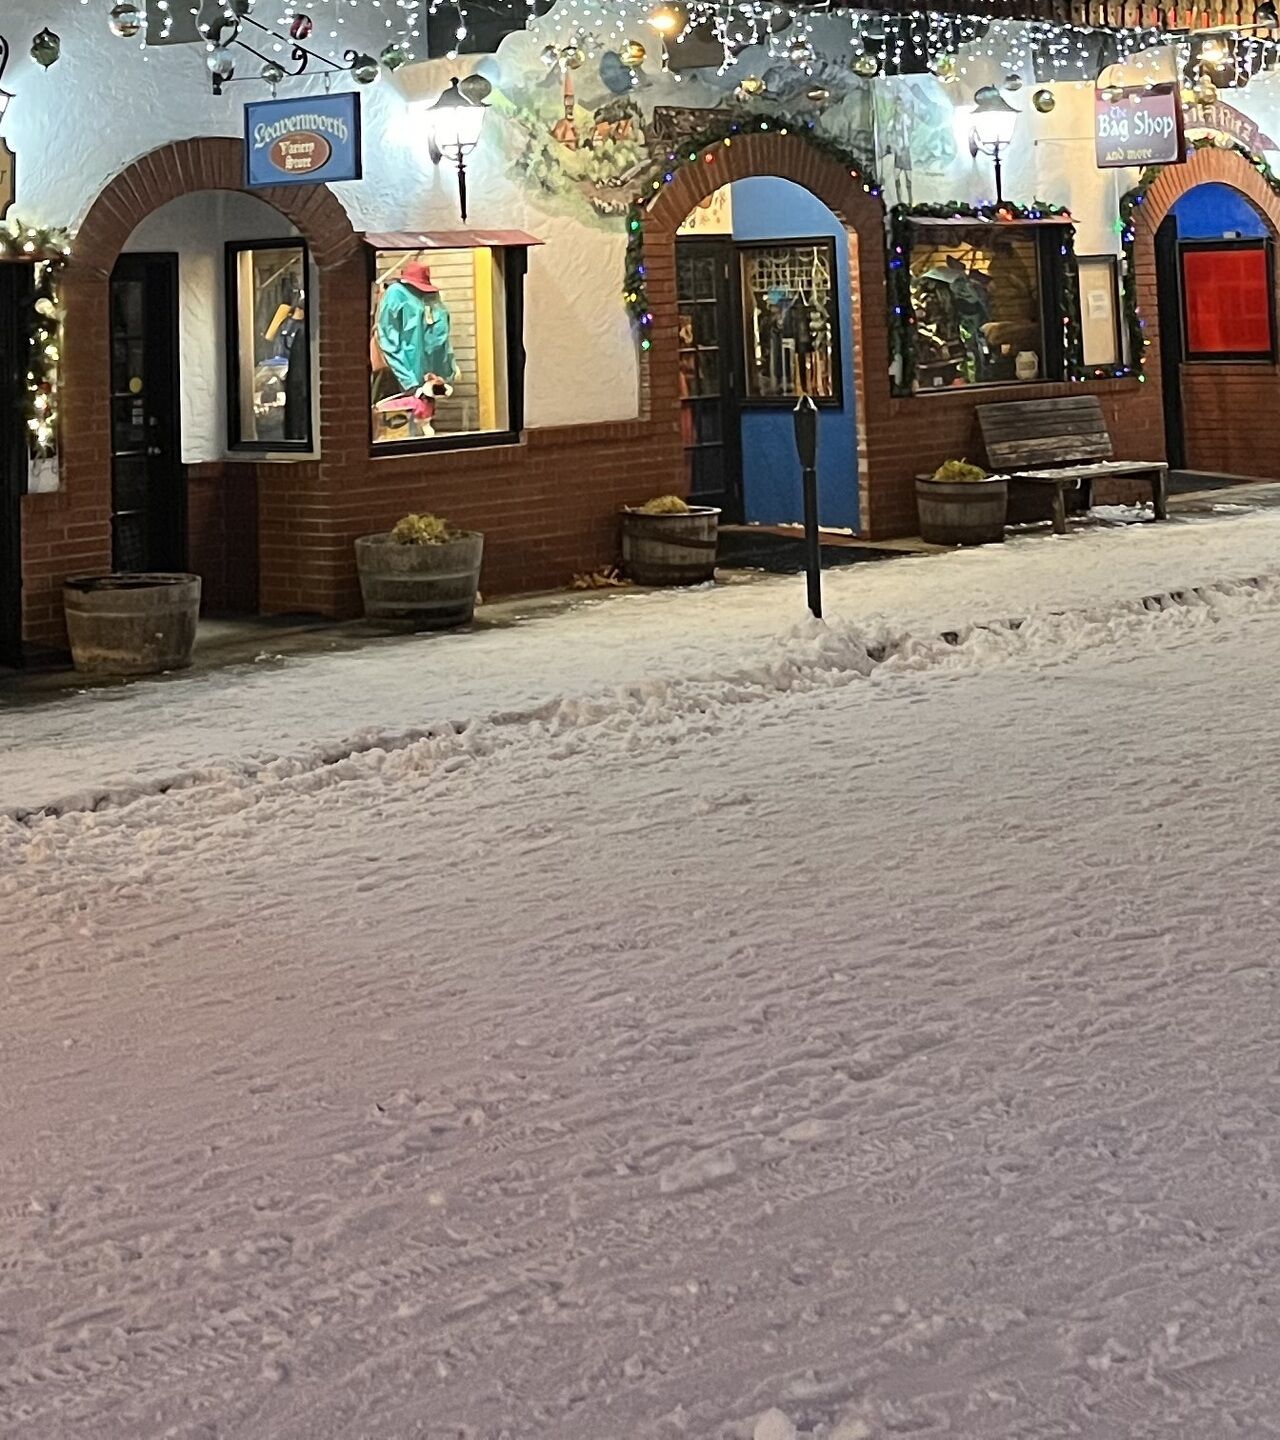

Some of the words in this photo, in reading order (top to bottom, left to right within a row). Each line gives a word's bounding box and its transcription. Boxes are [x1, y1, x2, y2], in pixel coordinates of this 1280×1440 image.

[254, 114, 348, 150] Leavenworth
[1098, 114, 1130, 142] Bag
[1133, 111, 1173, 138] Shop
